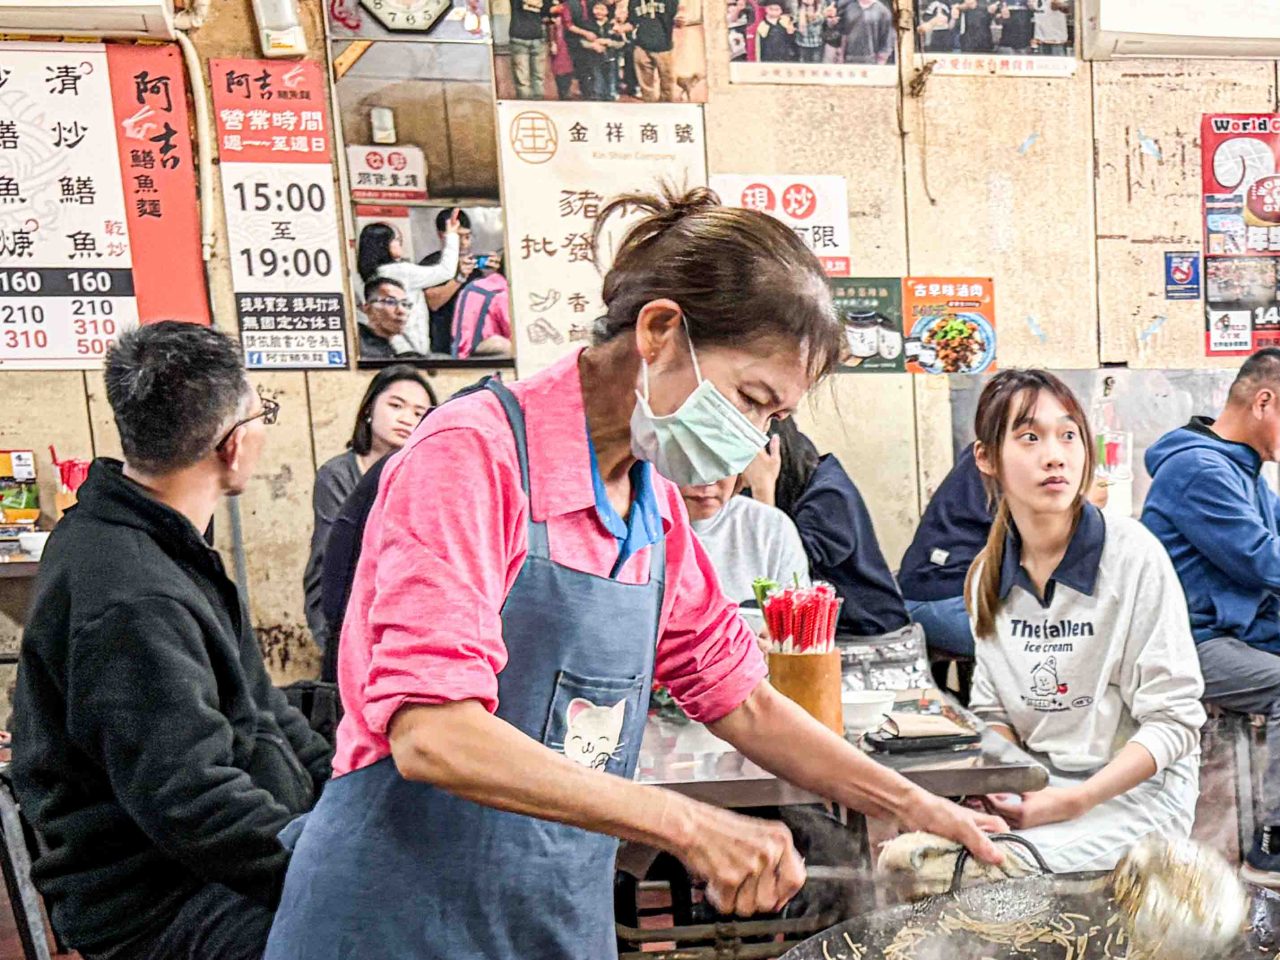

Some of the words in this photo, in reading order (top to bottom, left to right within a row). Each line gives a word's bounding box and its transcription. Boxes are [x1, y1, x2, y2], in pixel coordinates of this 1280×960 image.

[225, 69, 273, 99] 阿吉
[133, 71, 181, 170] 阿吉
[220, 108, 324, 131] 營業時間
[1214, 119, 1269, 132] World
[568, 121, 695, 144] 金祥商號
[45, 65, 104, 259] 清炒鱔魚
[130, 149, 163, 218] 鱔魚麵
[233, 182, 326, 212] 15:00
[270, 220, 297, 242] 至
[240, 247, 332, 278] 19:00
[0, 271, 42, 293] 160
[67, 271, 112, 293] 160
[1, 305, 45, 324] 210
[71, 299, 114, 316] 210
[73, 318, 116, 335] 310
[4, 329, 48, 348] 310
[1011, 619, 1041, 638] The
[1042, 618, 1094, 639] fallen
[1024, 641, 1041, 653] ice
[1043, 643, 1073, 653] cream
